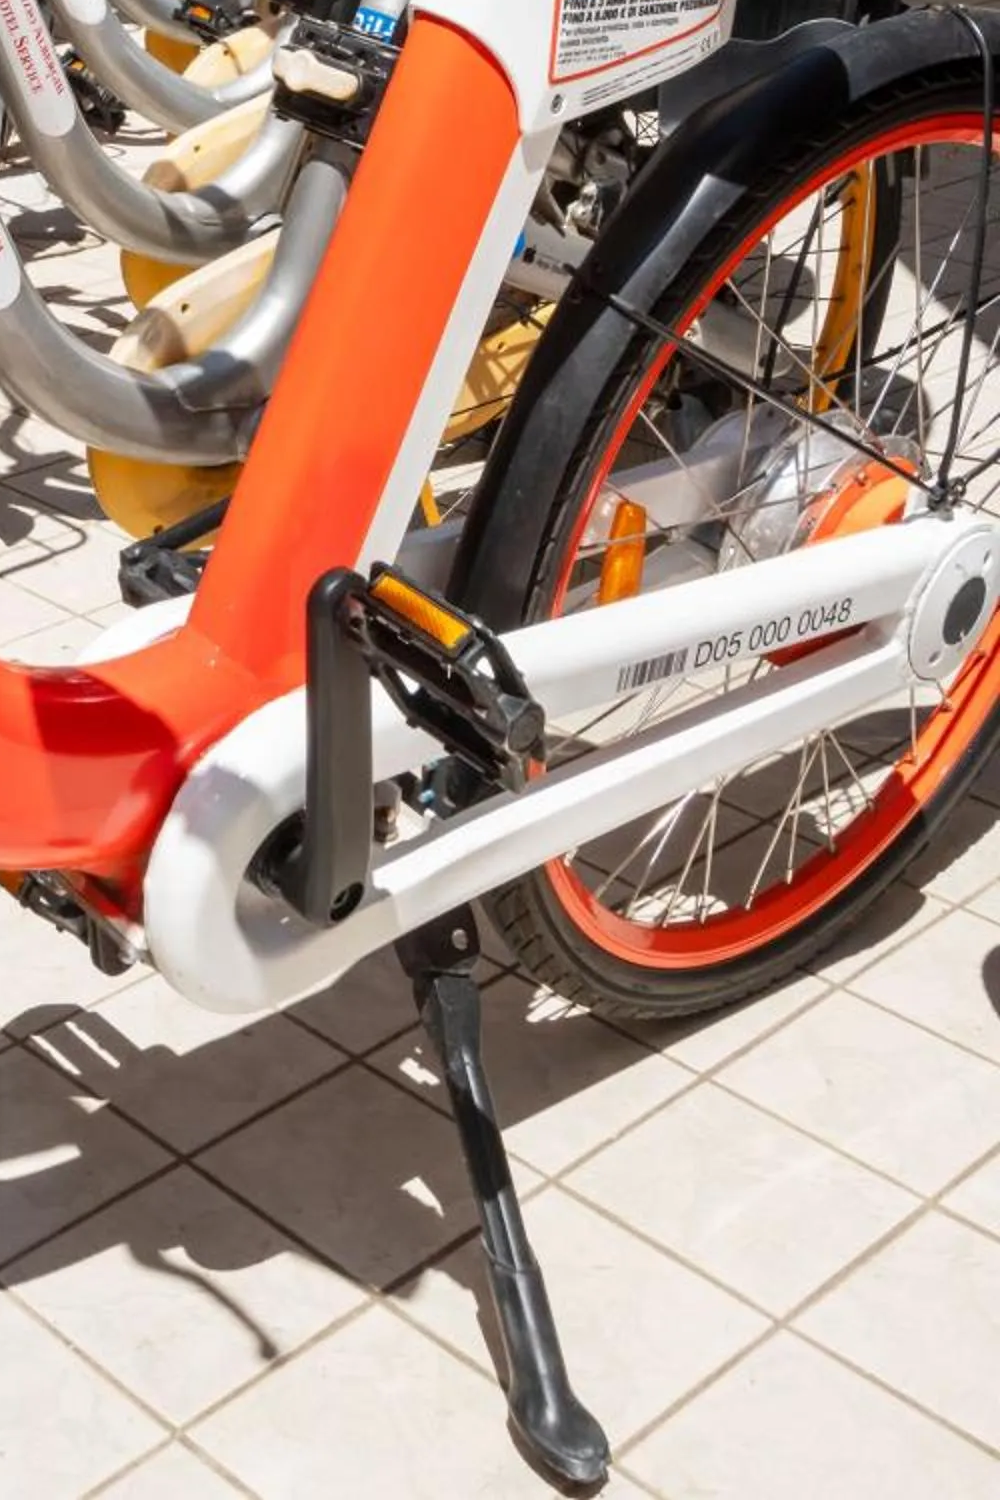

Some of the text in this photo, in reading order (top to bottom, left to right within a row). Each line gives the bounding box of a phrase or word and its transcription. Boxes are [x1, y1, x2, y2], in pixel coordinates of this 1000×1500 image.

[693, 597, 853, 668] D05 000 0048
